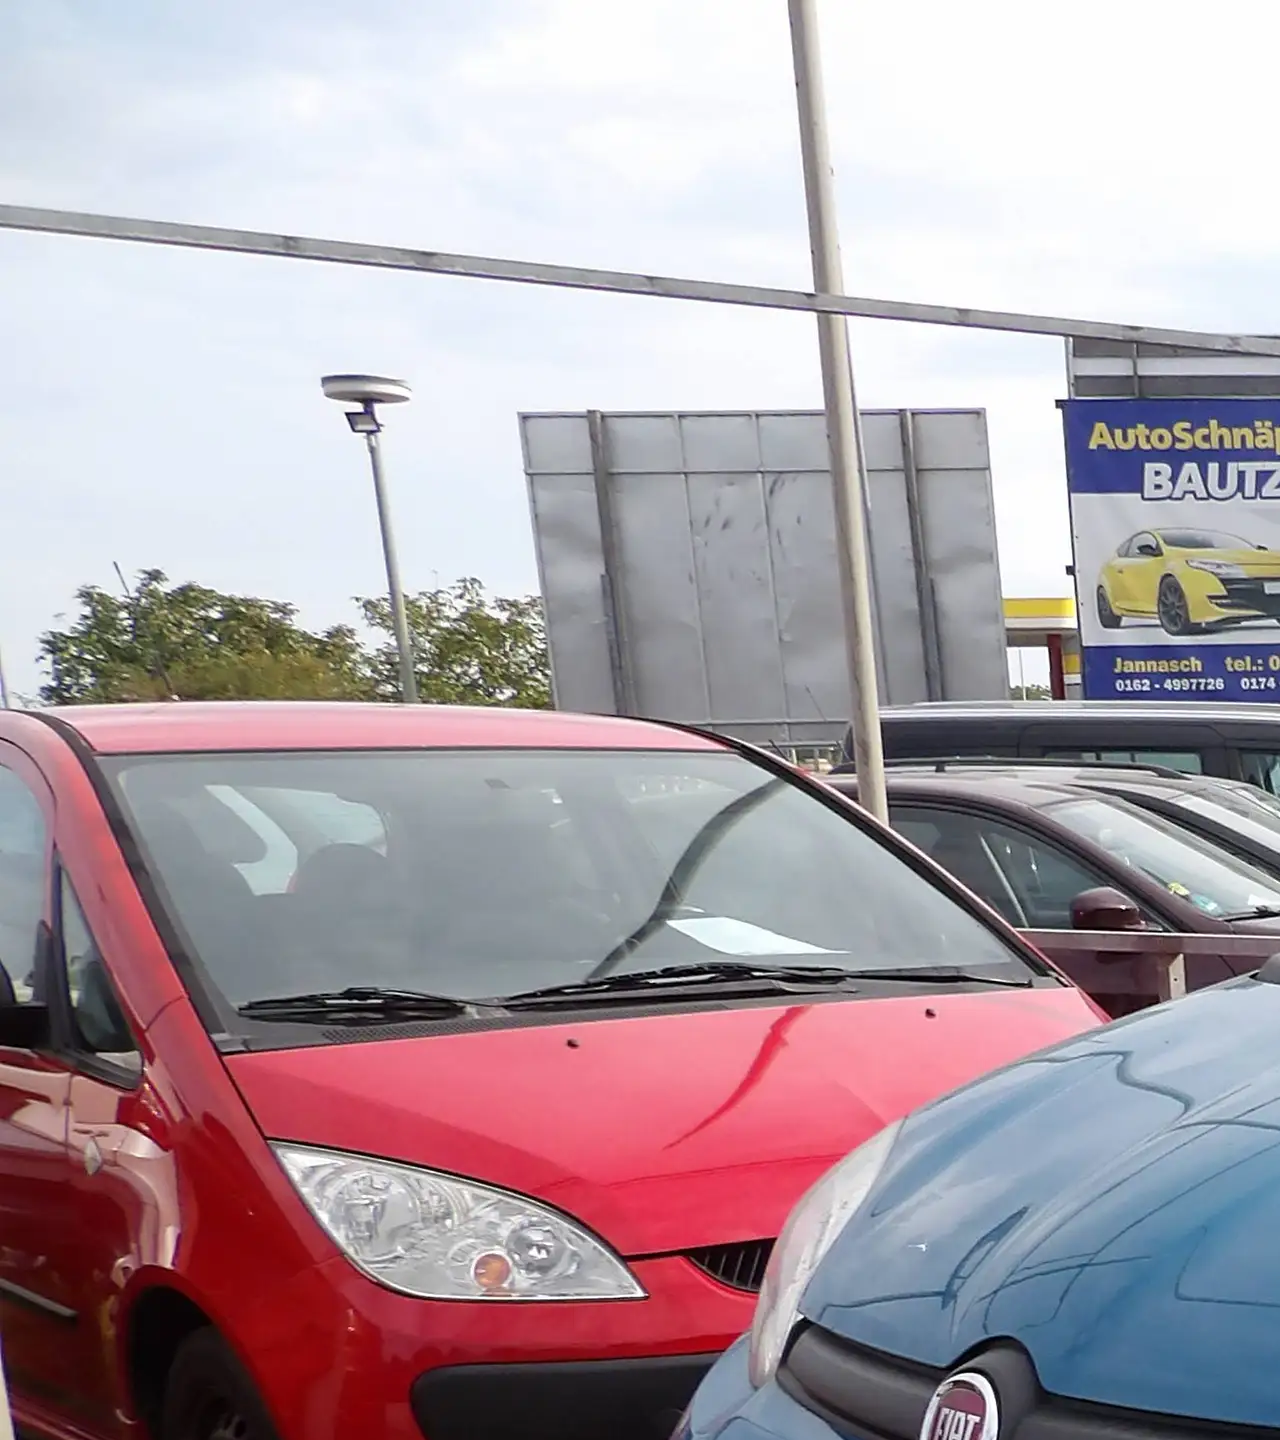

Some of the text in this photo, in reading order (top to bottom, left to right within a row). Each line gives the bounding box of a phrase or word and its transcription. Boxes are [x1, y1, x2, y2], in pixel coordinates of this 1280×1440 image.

[1114, 656, 1203, 674] Jannasch
[1115, 679, 1151, 692] 0162
[1163, 677, 1225, 692] 4997726
[1240, 677, 1277, 690] 0174
